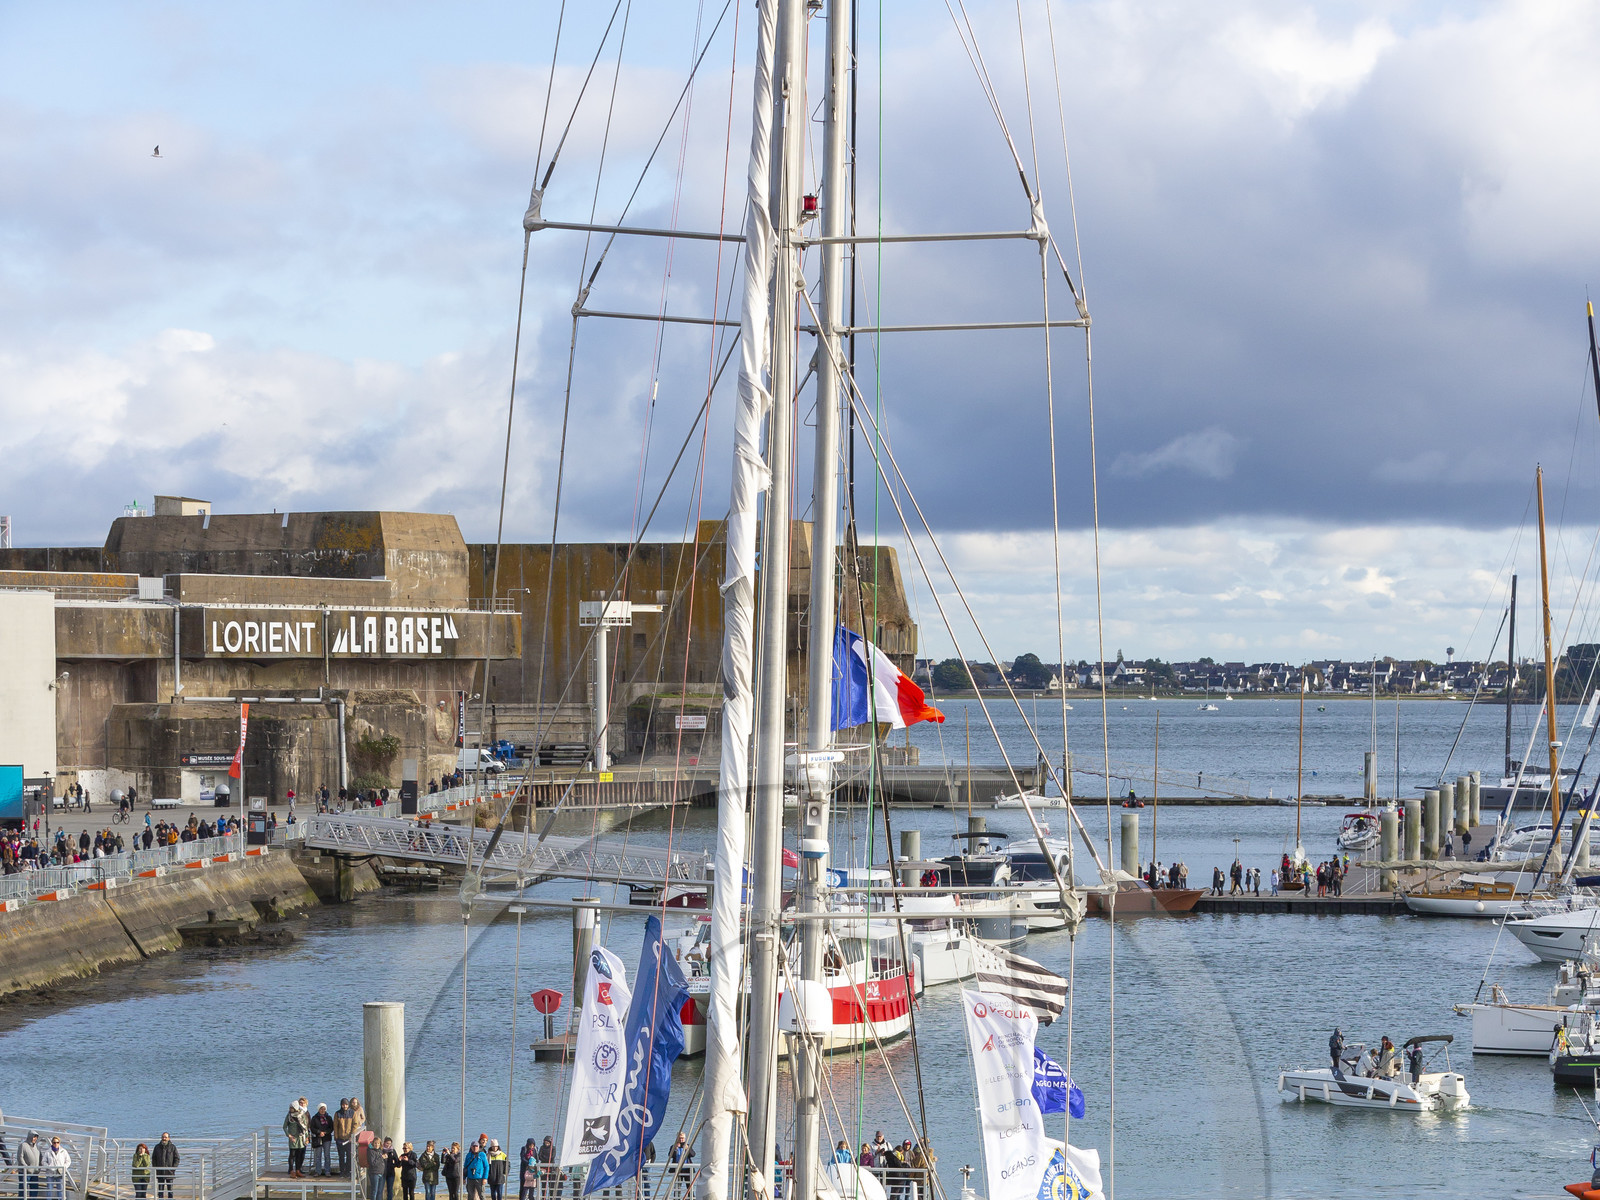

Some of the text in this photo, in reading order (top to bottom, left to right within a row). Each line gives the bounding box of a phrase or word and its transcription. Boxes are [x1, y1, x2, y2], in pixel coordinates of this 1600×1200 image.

[212, 616, 442, 654] LORIENT LA BASE
[593, 1014, 614, 1028] PSL
[989, 1005, 1031, 1019] VEOLIA
[1001, 1156, 1036, 1180] OCEANS
